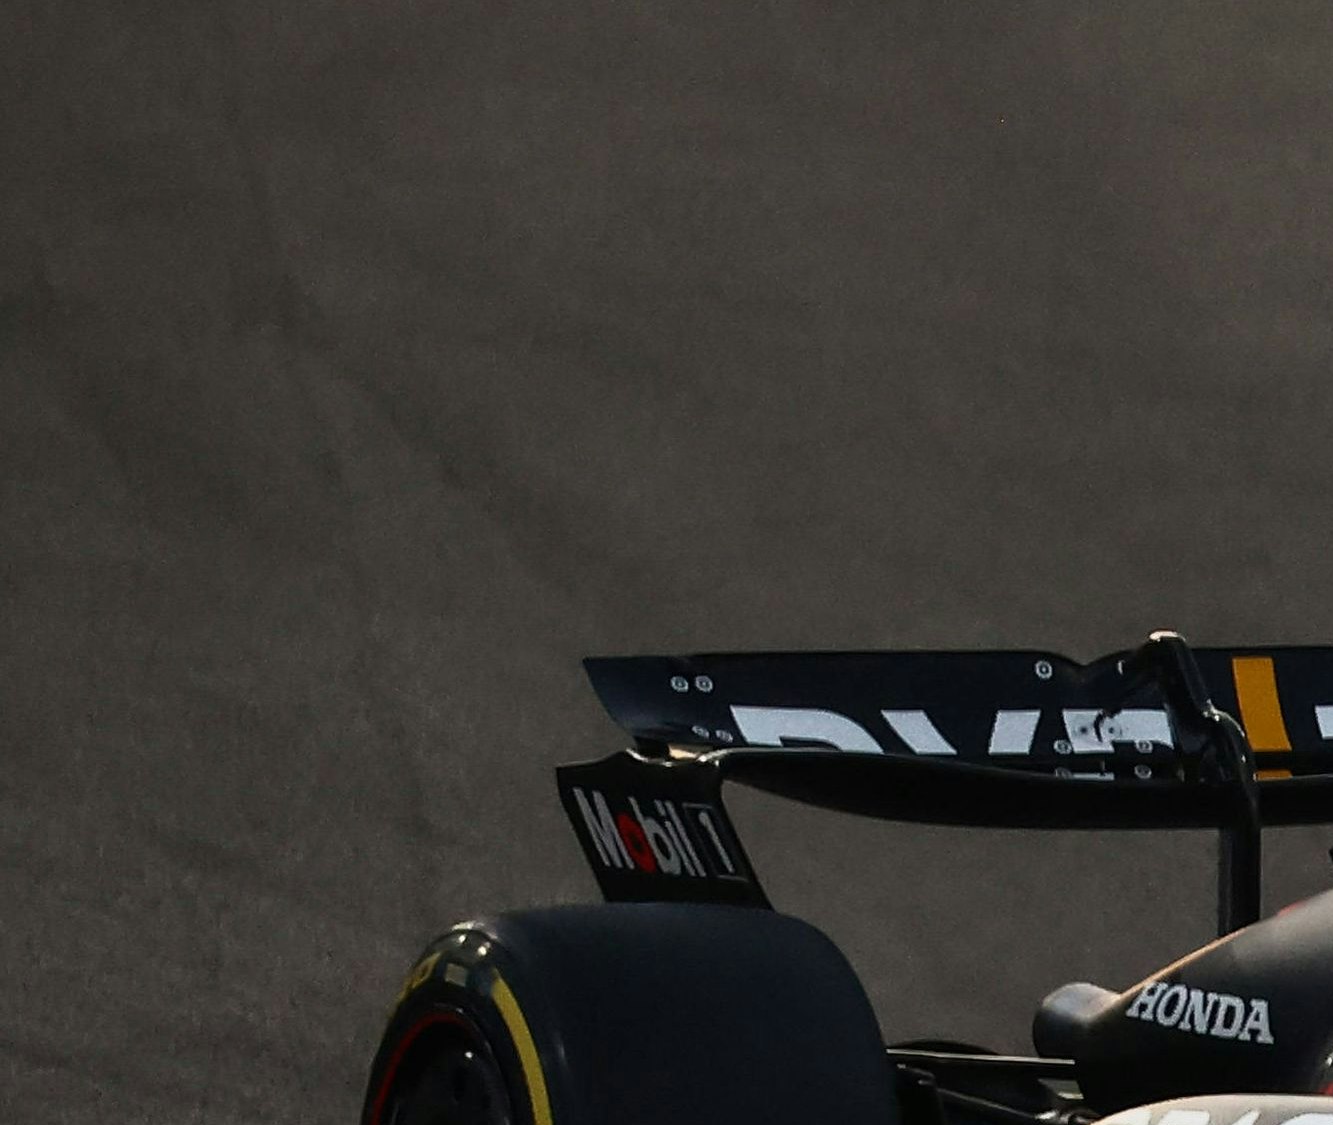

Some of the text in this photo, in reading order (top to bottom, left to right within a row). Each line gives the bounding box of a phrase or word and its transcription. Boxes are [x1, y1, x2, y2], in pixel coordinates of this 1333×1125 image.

[573, 786, 735, 877] Mobil 1
[1126, 981, 1274, 1045] HONDA
